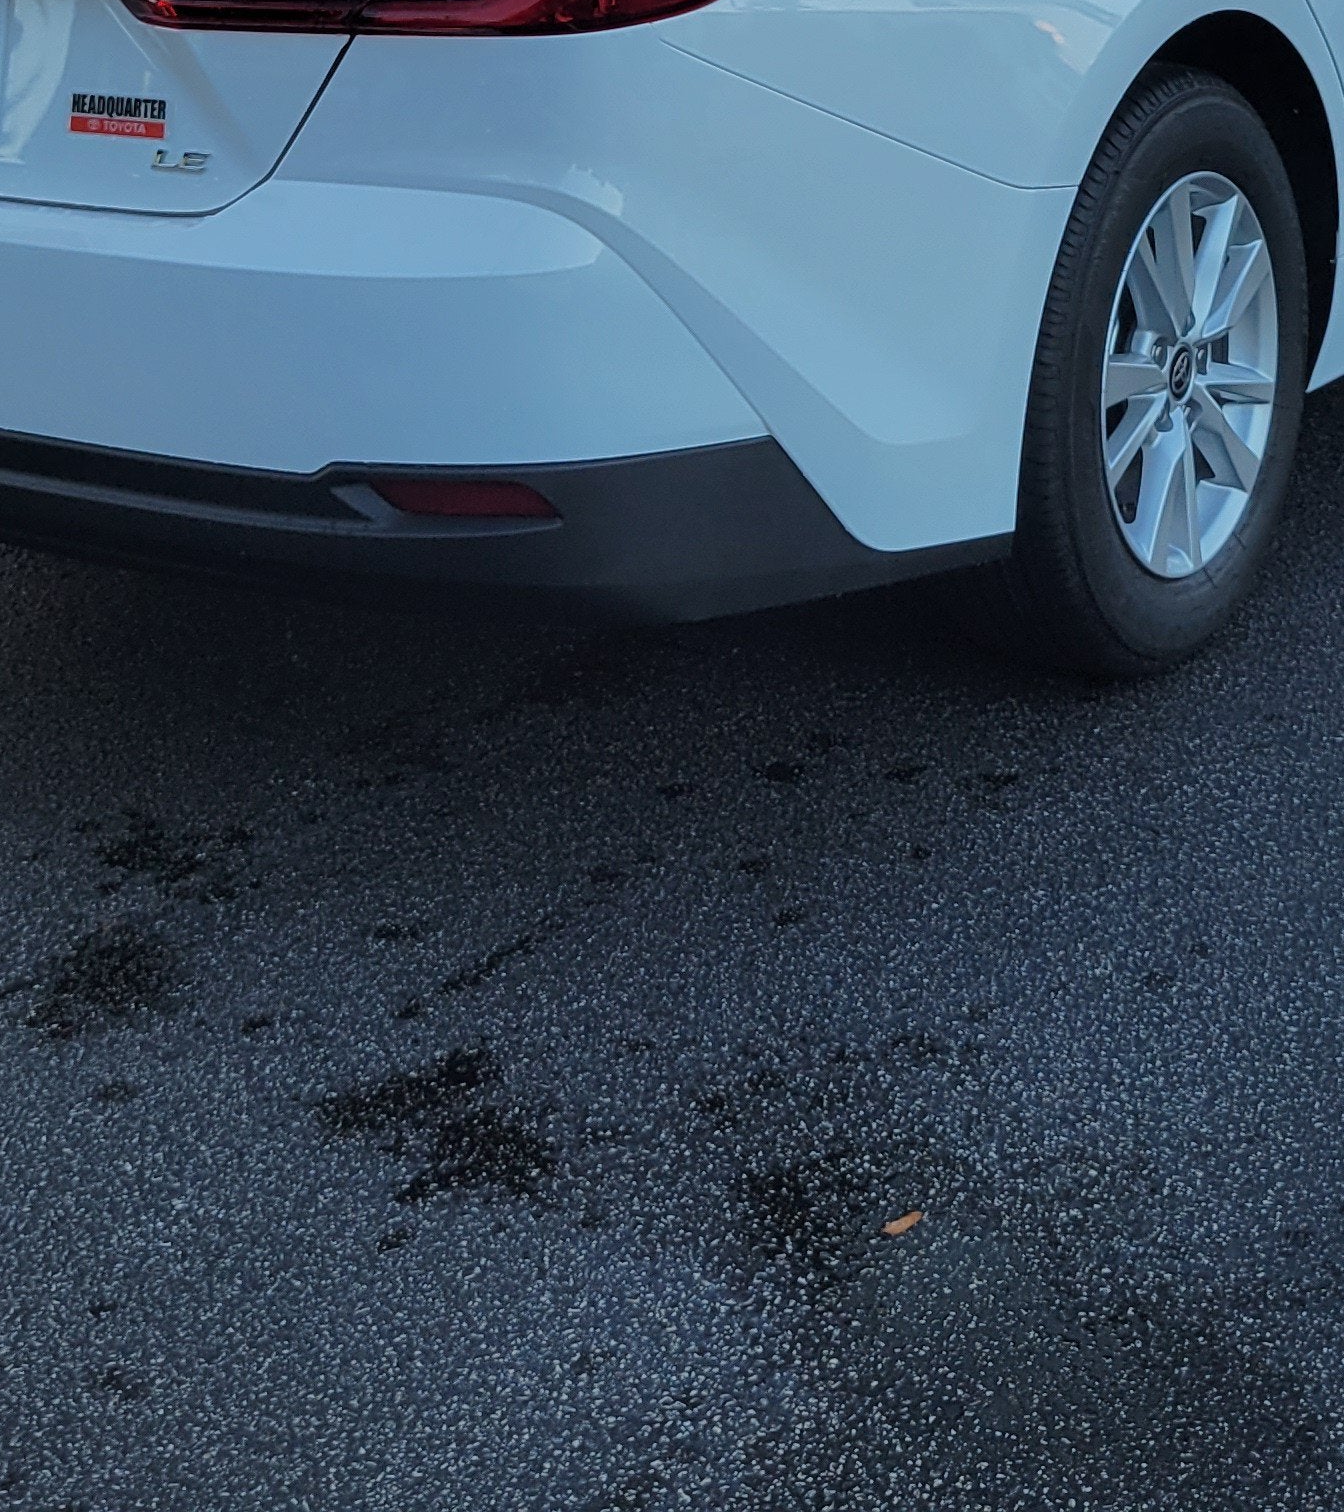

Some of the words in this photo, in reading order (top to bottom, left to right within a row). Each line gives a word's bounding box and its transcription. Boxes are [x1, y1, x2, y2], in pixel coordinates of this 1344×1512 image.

[71, 93, 167, 120] HEADQUARTER
[103, 120, 146, 134] TOYOTA
[151, 149, 212, 175] LE
